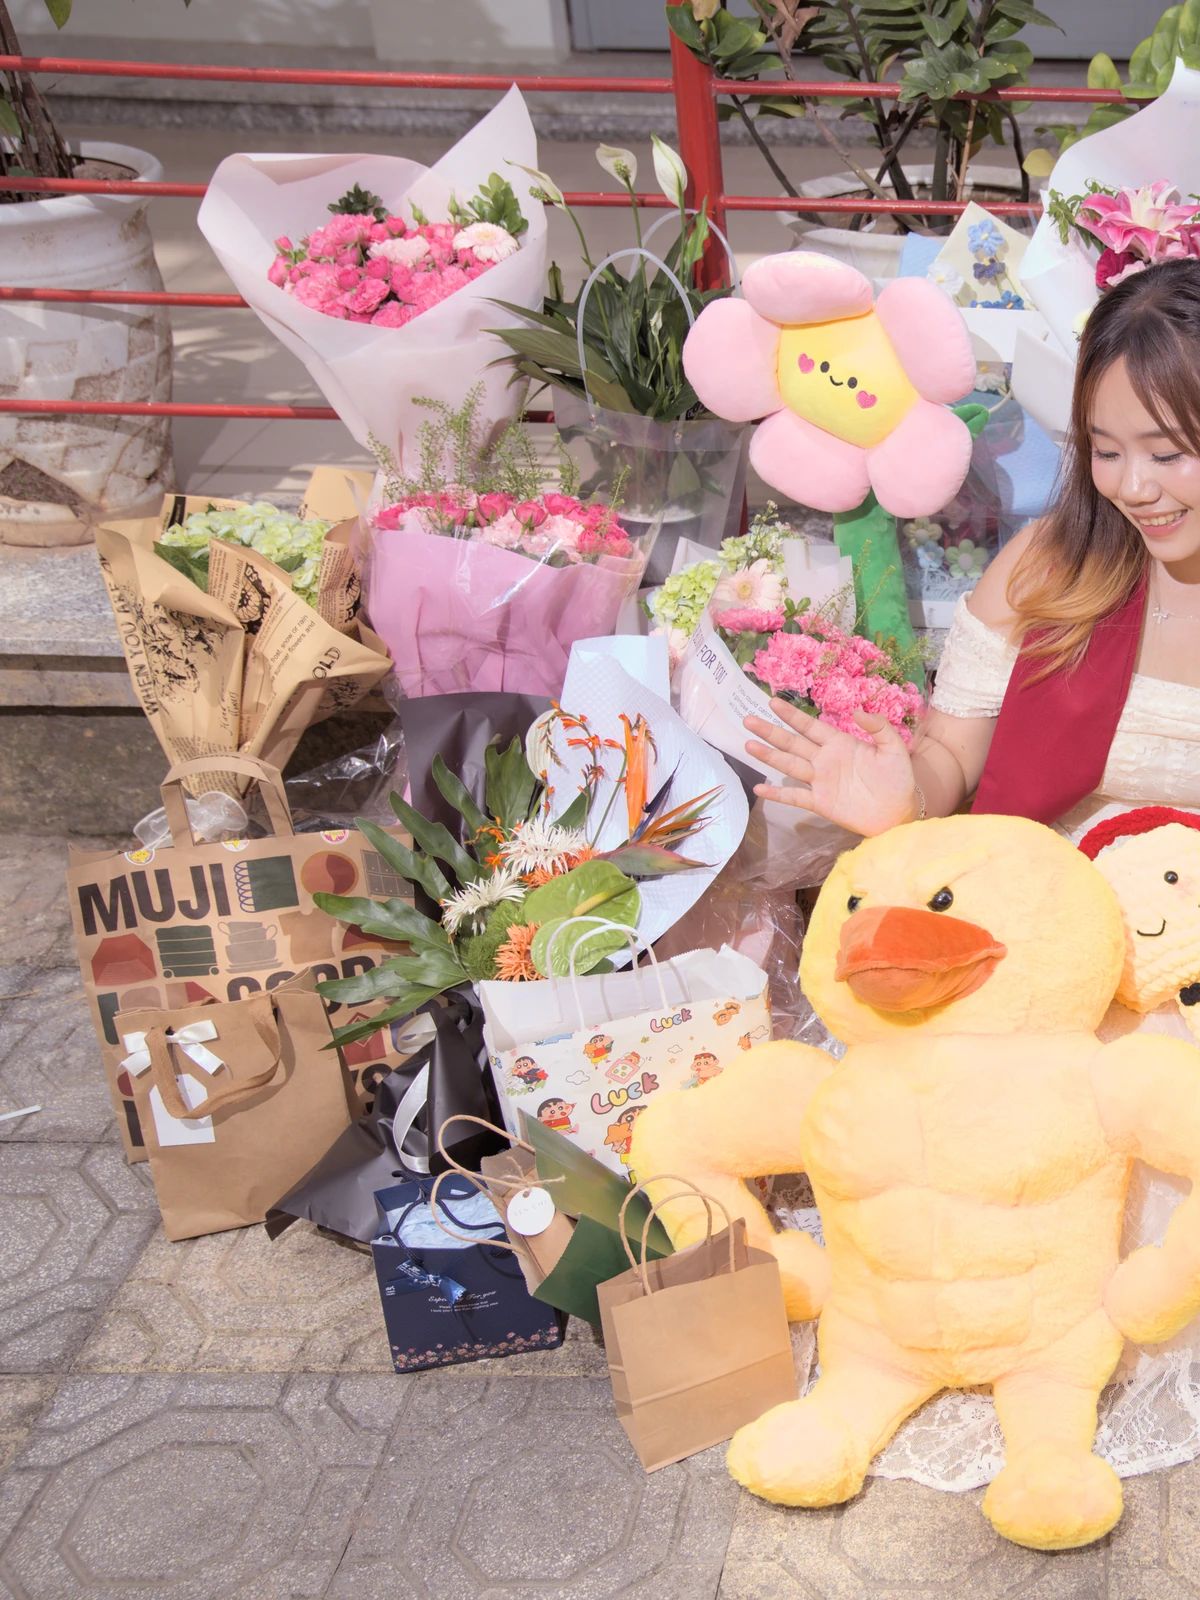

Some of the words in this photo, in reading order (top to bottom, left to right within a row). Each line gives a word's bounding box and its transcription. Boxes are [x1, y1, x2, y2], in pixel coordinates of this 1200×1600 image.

[233, 558, 244, 590] Beautiful
[120, 621, 144, 659] YOU
[273, 652, 291, 676] summer
[289, 632, 307, 655] flowers
[305, 620, 317, 634] and
[280, 633, 294, 650] snow
[291, 626, 298, 634] or
[297, 614, 309, 628] rain
[312, 646, 341, 681] OLD
[697, 644, 718, 670] FOR
[712, 660, 728, 686] YOU
[133, 664, 159, 716] WHEN
[743, 693, 760, 709] could
[756, 704, 774, 720] catch
[77, 862, 232, 937] MUJI
